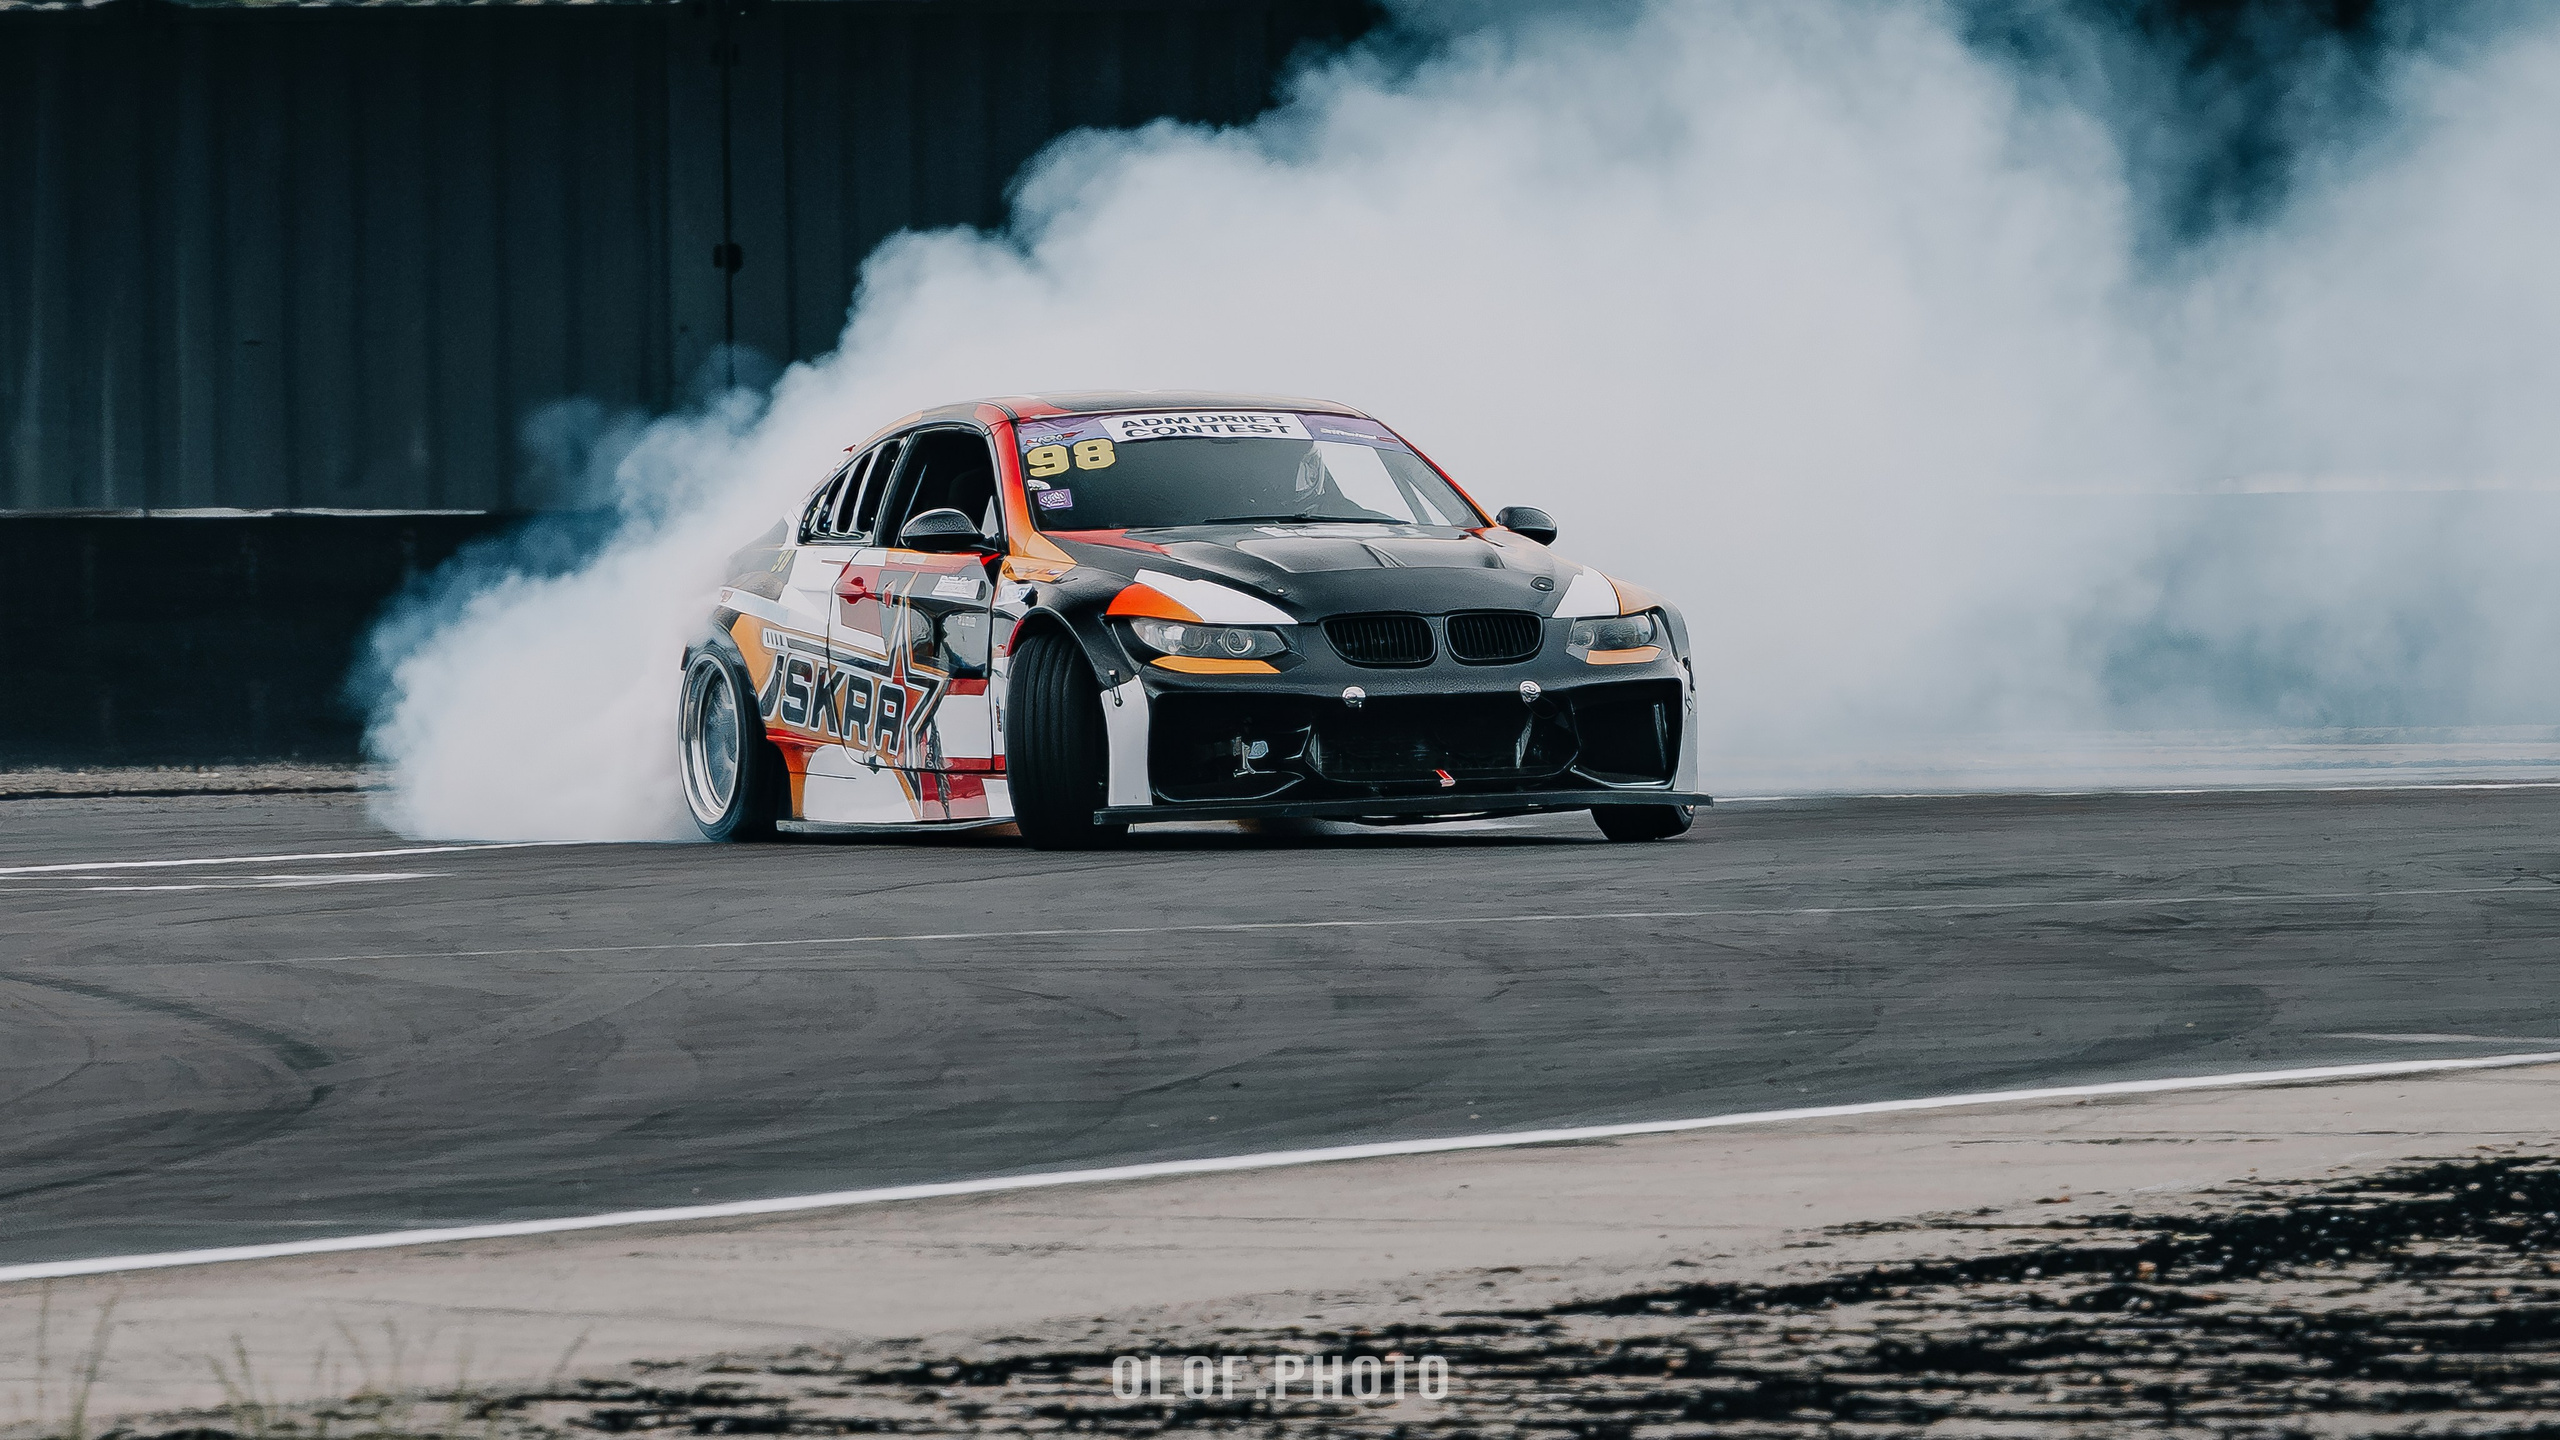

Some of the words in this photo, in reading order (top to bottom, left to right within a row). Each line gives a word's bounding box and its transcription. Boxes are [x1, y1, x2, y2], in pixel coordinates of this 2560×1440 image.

[1121, 417, 1191, 429] ADM
[1195, 415, 1284, 424] DRIFT
[1125, 424, 1291, 438] CONTEST
[1026, 438, 1117, 478] 98
